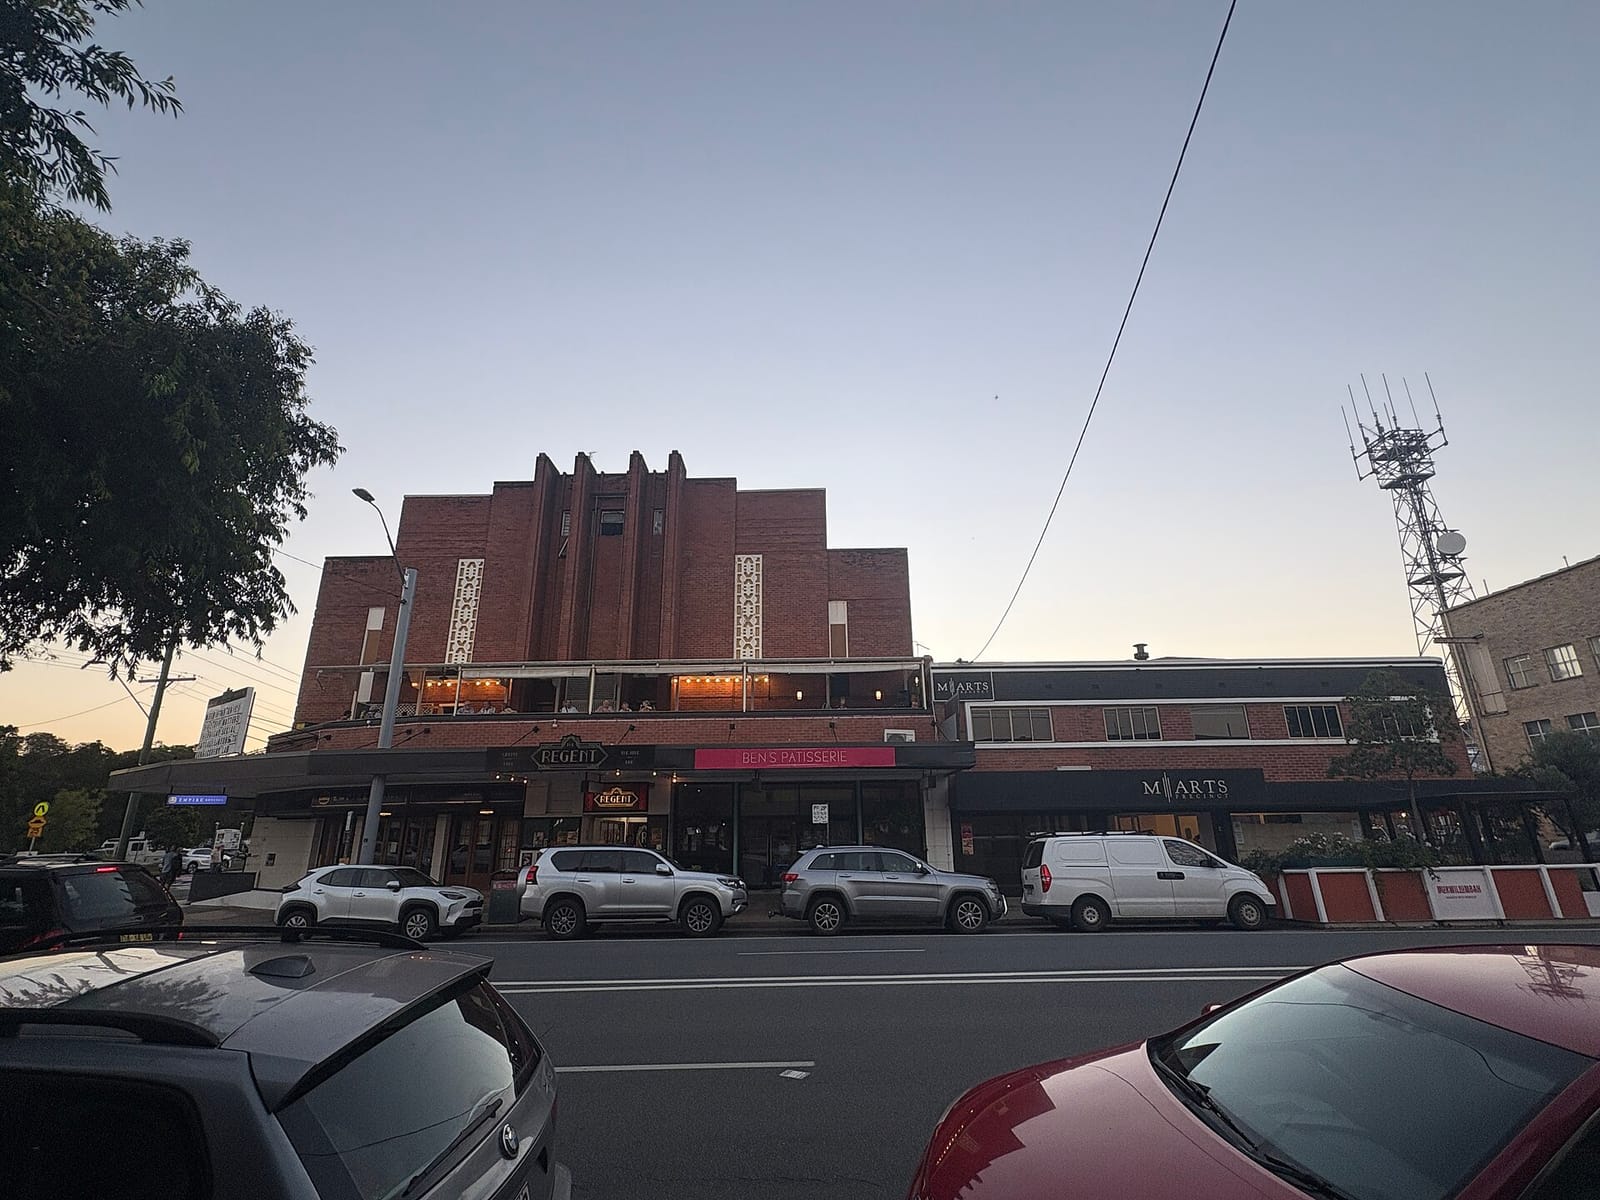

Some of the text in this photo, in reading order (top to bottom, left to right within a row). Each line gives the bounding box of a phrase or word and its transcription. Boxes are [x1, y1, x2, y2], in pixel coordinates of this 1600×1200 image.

[541, 749, 598, 764] REGENT
[742, 750, 848, 764] BEN'S PATISSERIE
[1175, 779, 1228, 794] ARTS
[599, 795, 632, 804] REGENT
